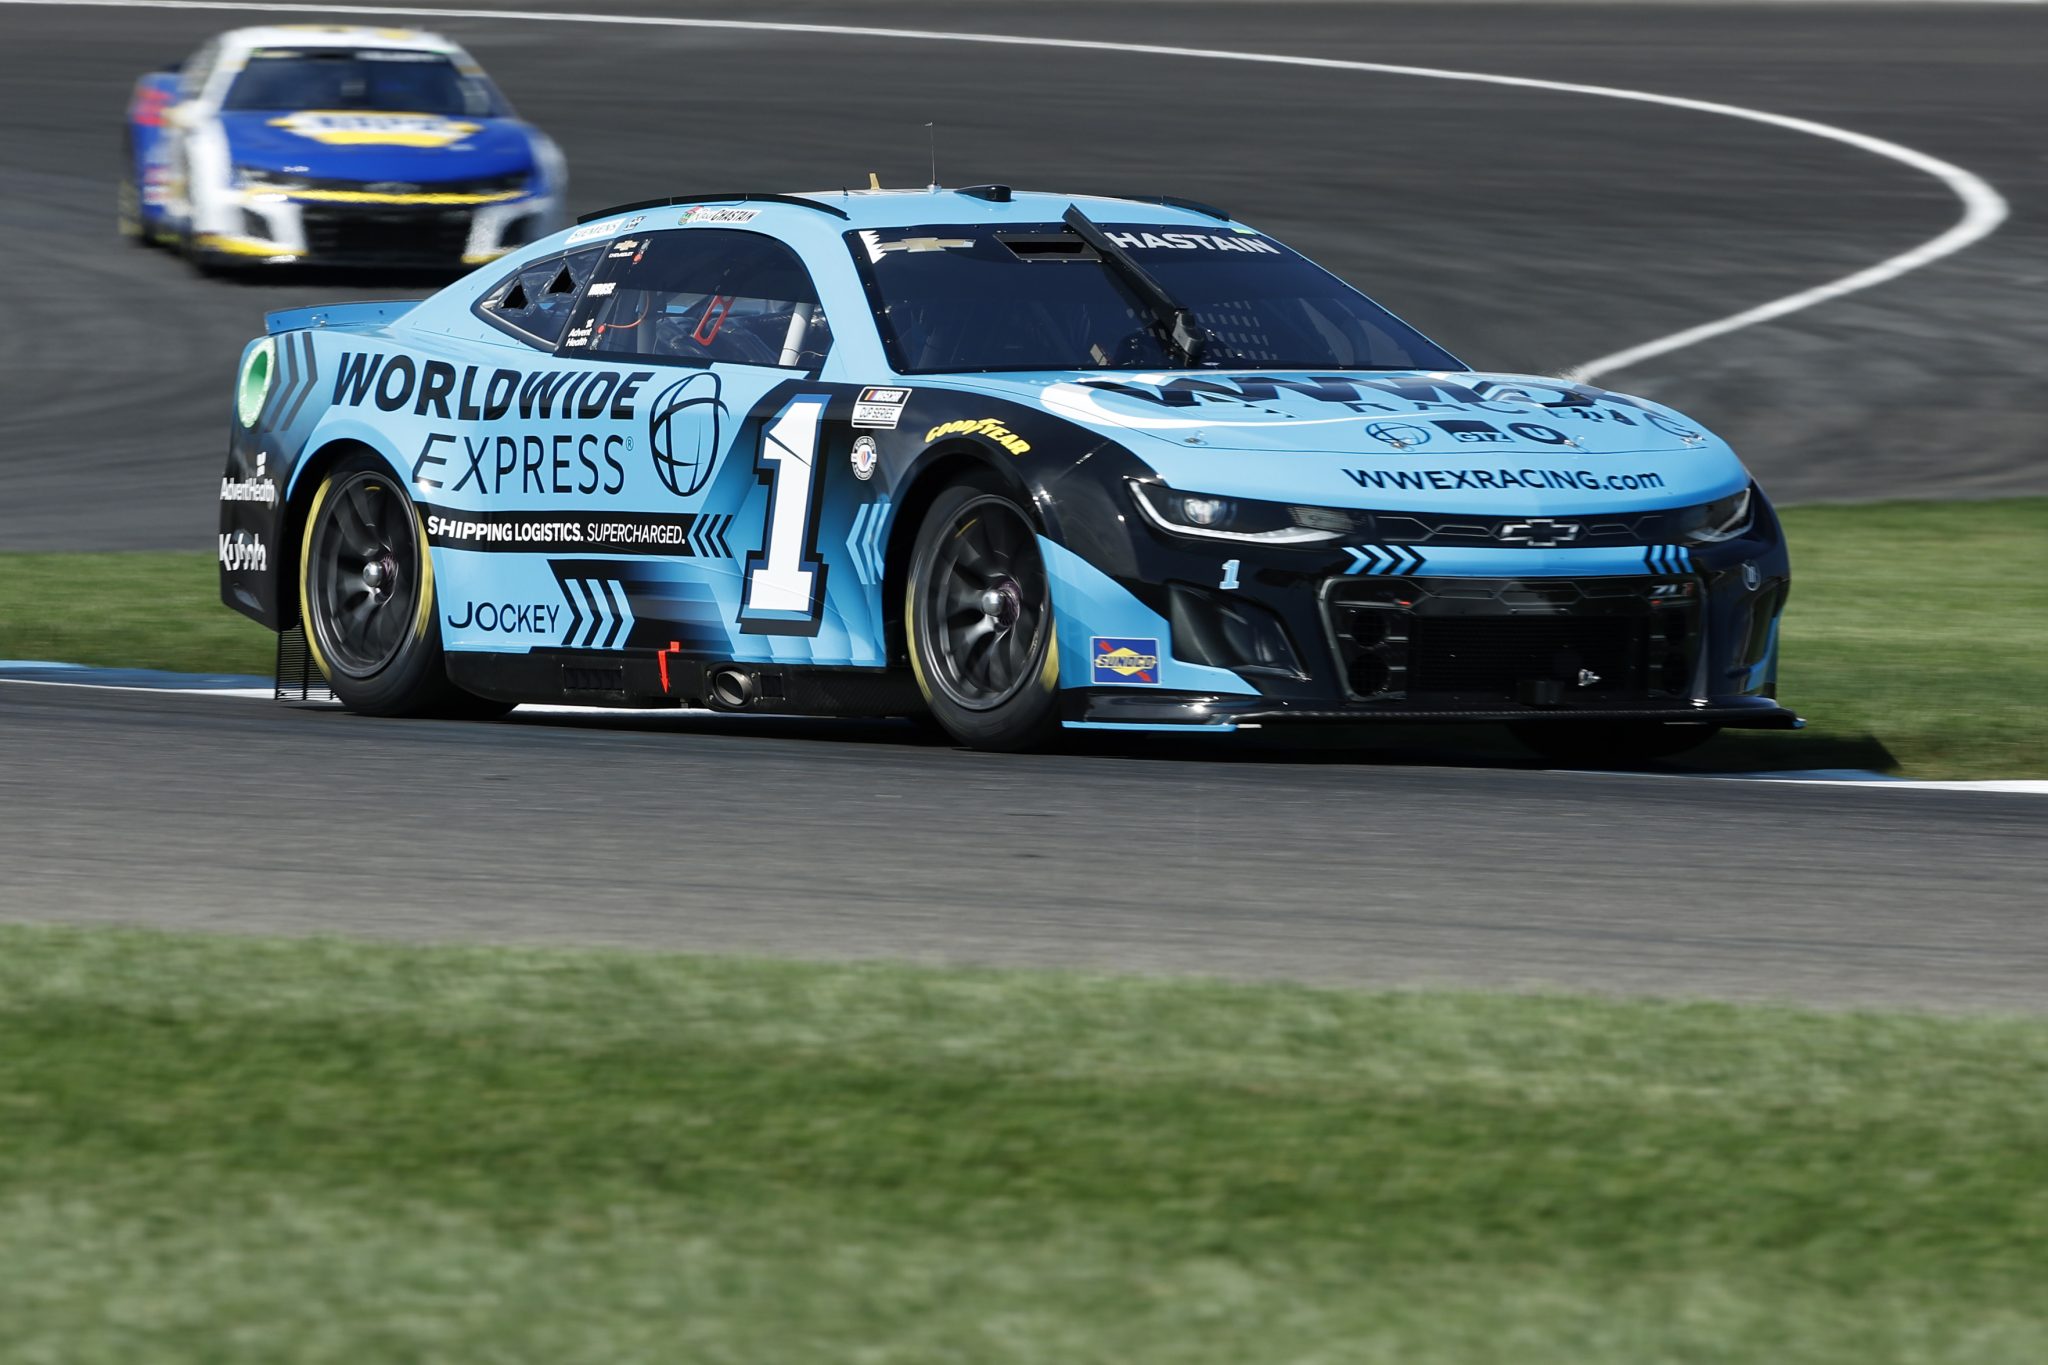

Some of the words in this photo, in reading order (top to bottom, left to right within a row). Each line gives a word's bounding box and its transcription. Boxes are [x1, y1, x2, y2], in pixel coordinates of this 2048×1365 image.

[1104, 232, 1281, 254] HASTAIN
[565, 337, 588, 347] Health
[331, 352, 655, 421] WORLDWIDE
[924, 417, 1031, 456] GOODYEAR
[219, 477, 275, 502] AdventHealth
[1342, 468, 1665, 491] WWEXRACING.com
[741, 394, 832, 621] 1
[427, 516, 512, 542] SHIPPING
[514, 523, 584, 542] LOGISTICS.
[587, 522, 686, 545] SUPERCHARGED.
[1218, 559, 1240, 590] 1
[448, 601, 560, 633] JOCKEY
[1098, 655, 1156, 668] SUNOCO
